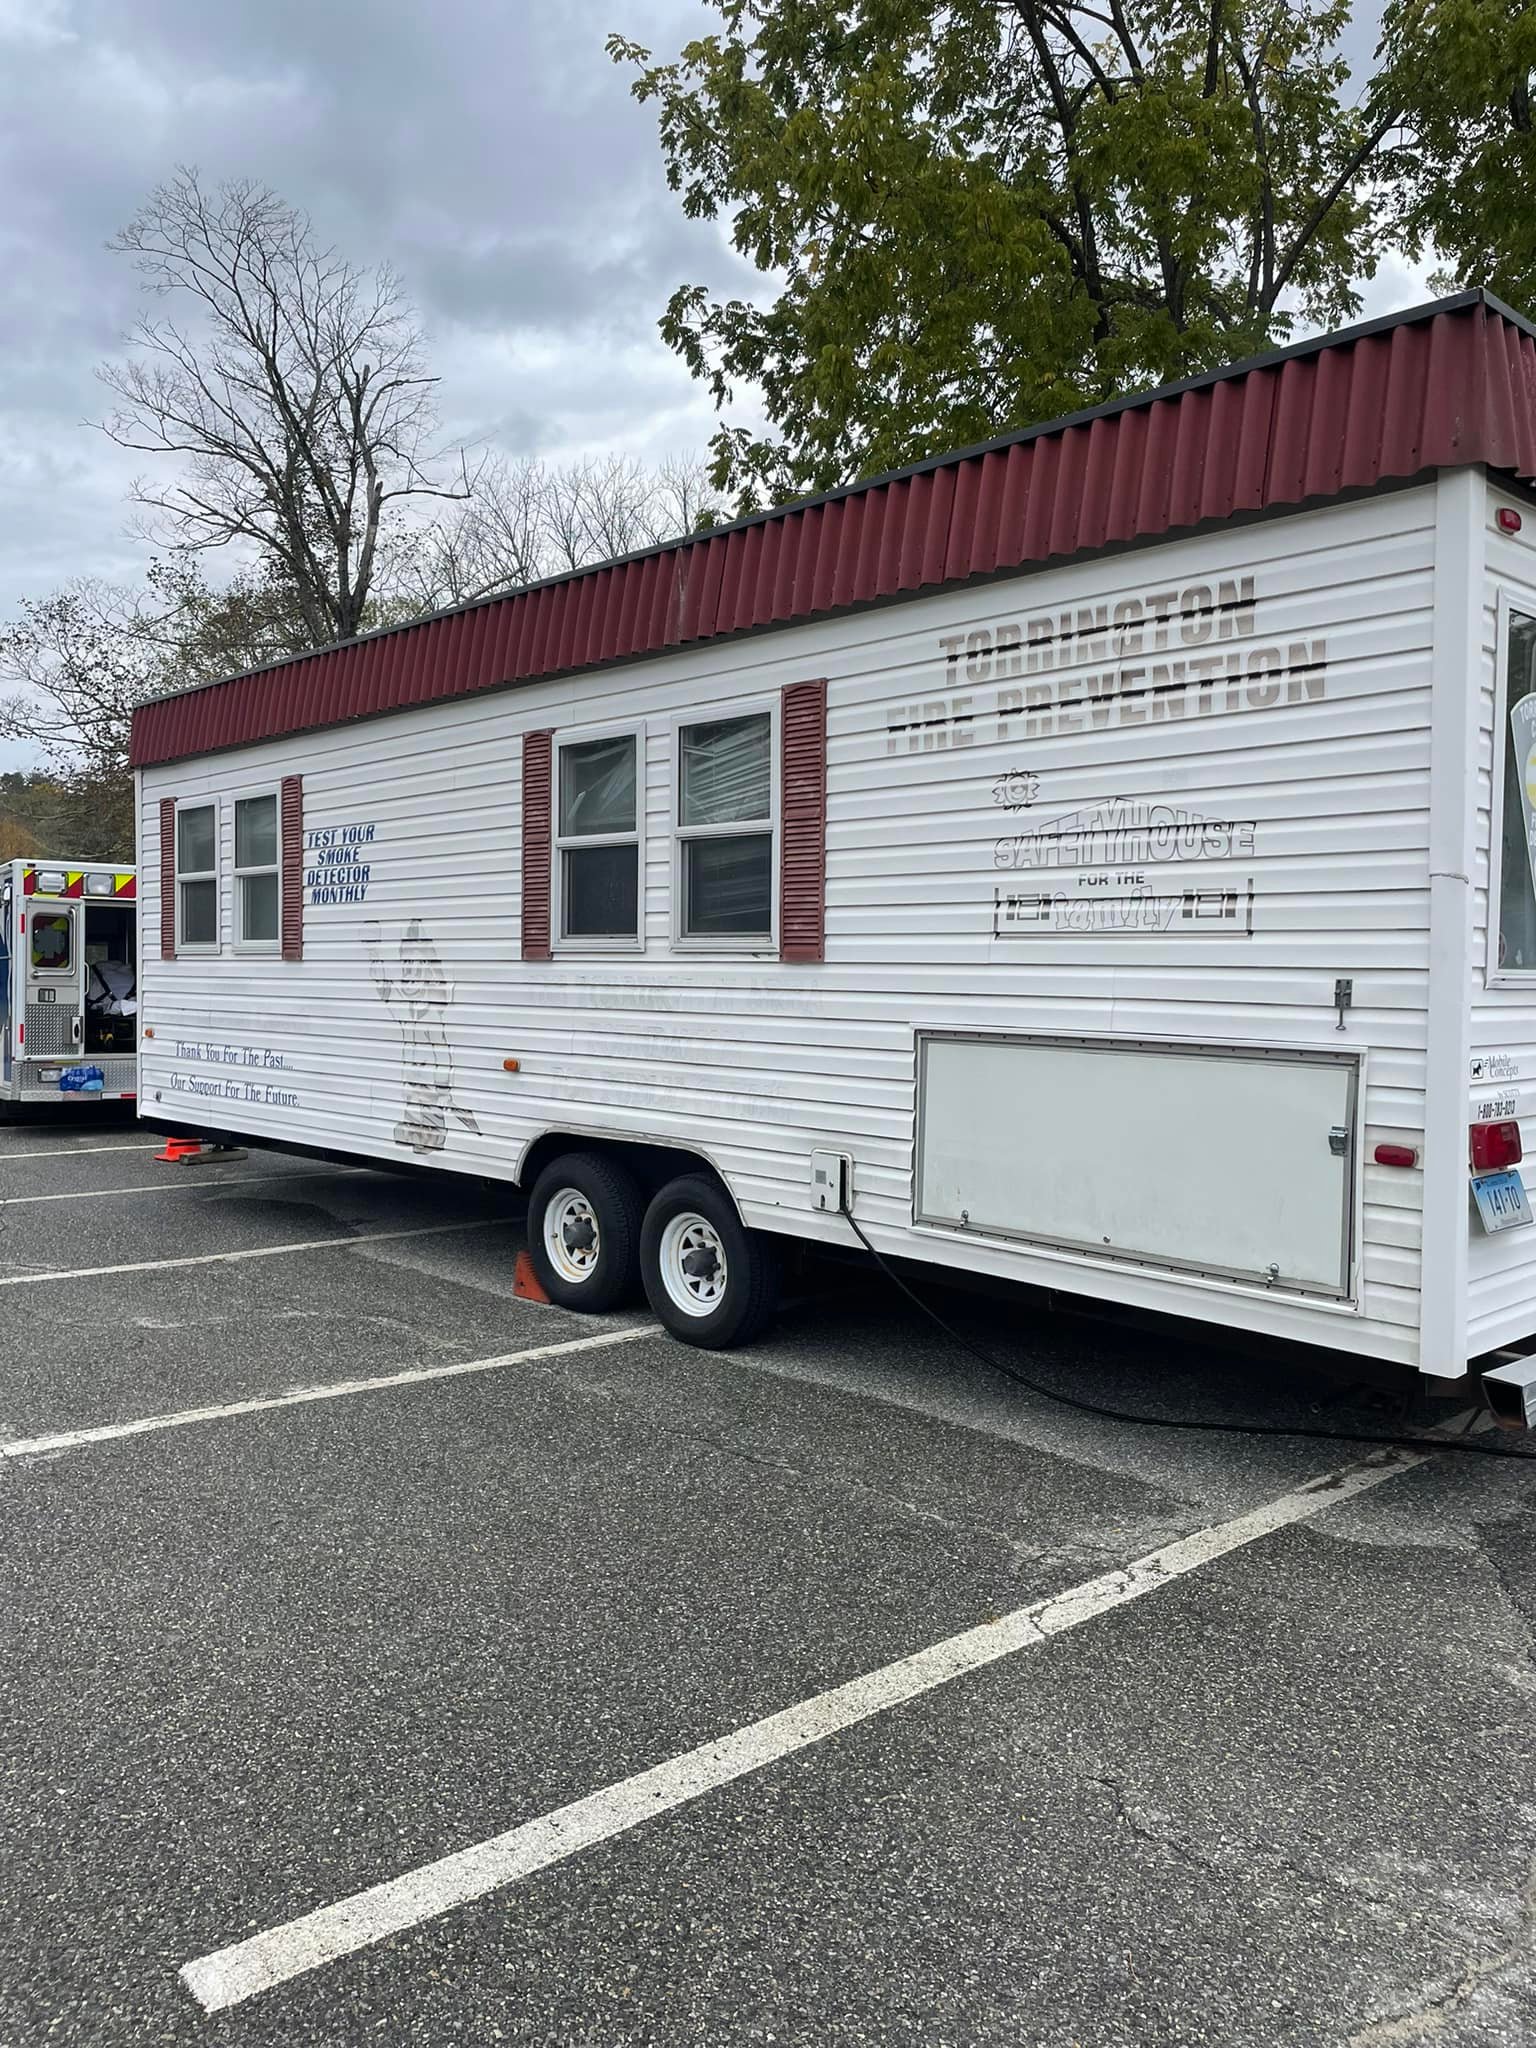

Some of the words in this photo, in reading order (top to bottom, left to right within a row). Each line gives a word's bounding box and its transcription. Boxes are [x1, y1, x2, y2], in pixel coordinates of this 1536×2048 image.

[939, 576, 1255, 686] TORRINGTON
[887, 697, 974, 754] FIRE
[997, 640, 1327, 738] PREVENTION
[308, 829, 338, 848] TEST
[342, 824, 375, 844] YOUR
[317, 846, 361, 866] SMOKE
[307, 865, 371, 886] DETECTOR
[1078, 873, 1109, 887] FOR
[1115, 871, 1144, 885] THE
[311, 884, 368, 905] MONTHLY
[175, 1041, 201, 1058] Thank
[205, 1043, 220, 1059] You
[223, 1045, 238, 1062] For
[242, 1048, 260, 1066] The
[170, 1072, 185, 1089] Our
[188, 1074, 222, 1096] Support
[225, 1080, 240, 1098] For
[243, 1081, 261, 1100] The
[265, 1085, 301, 1107] Future.
